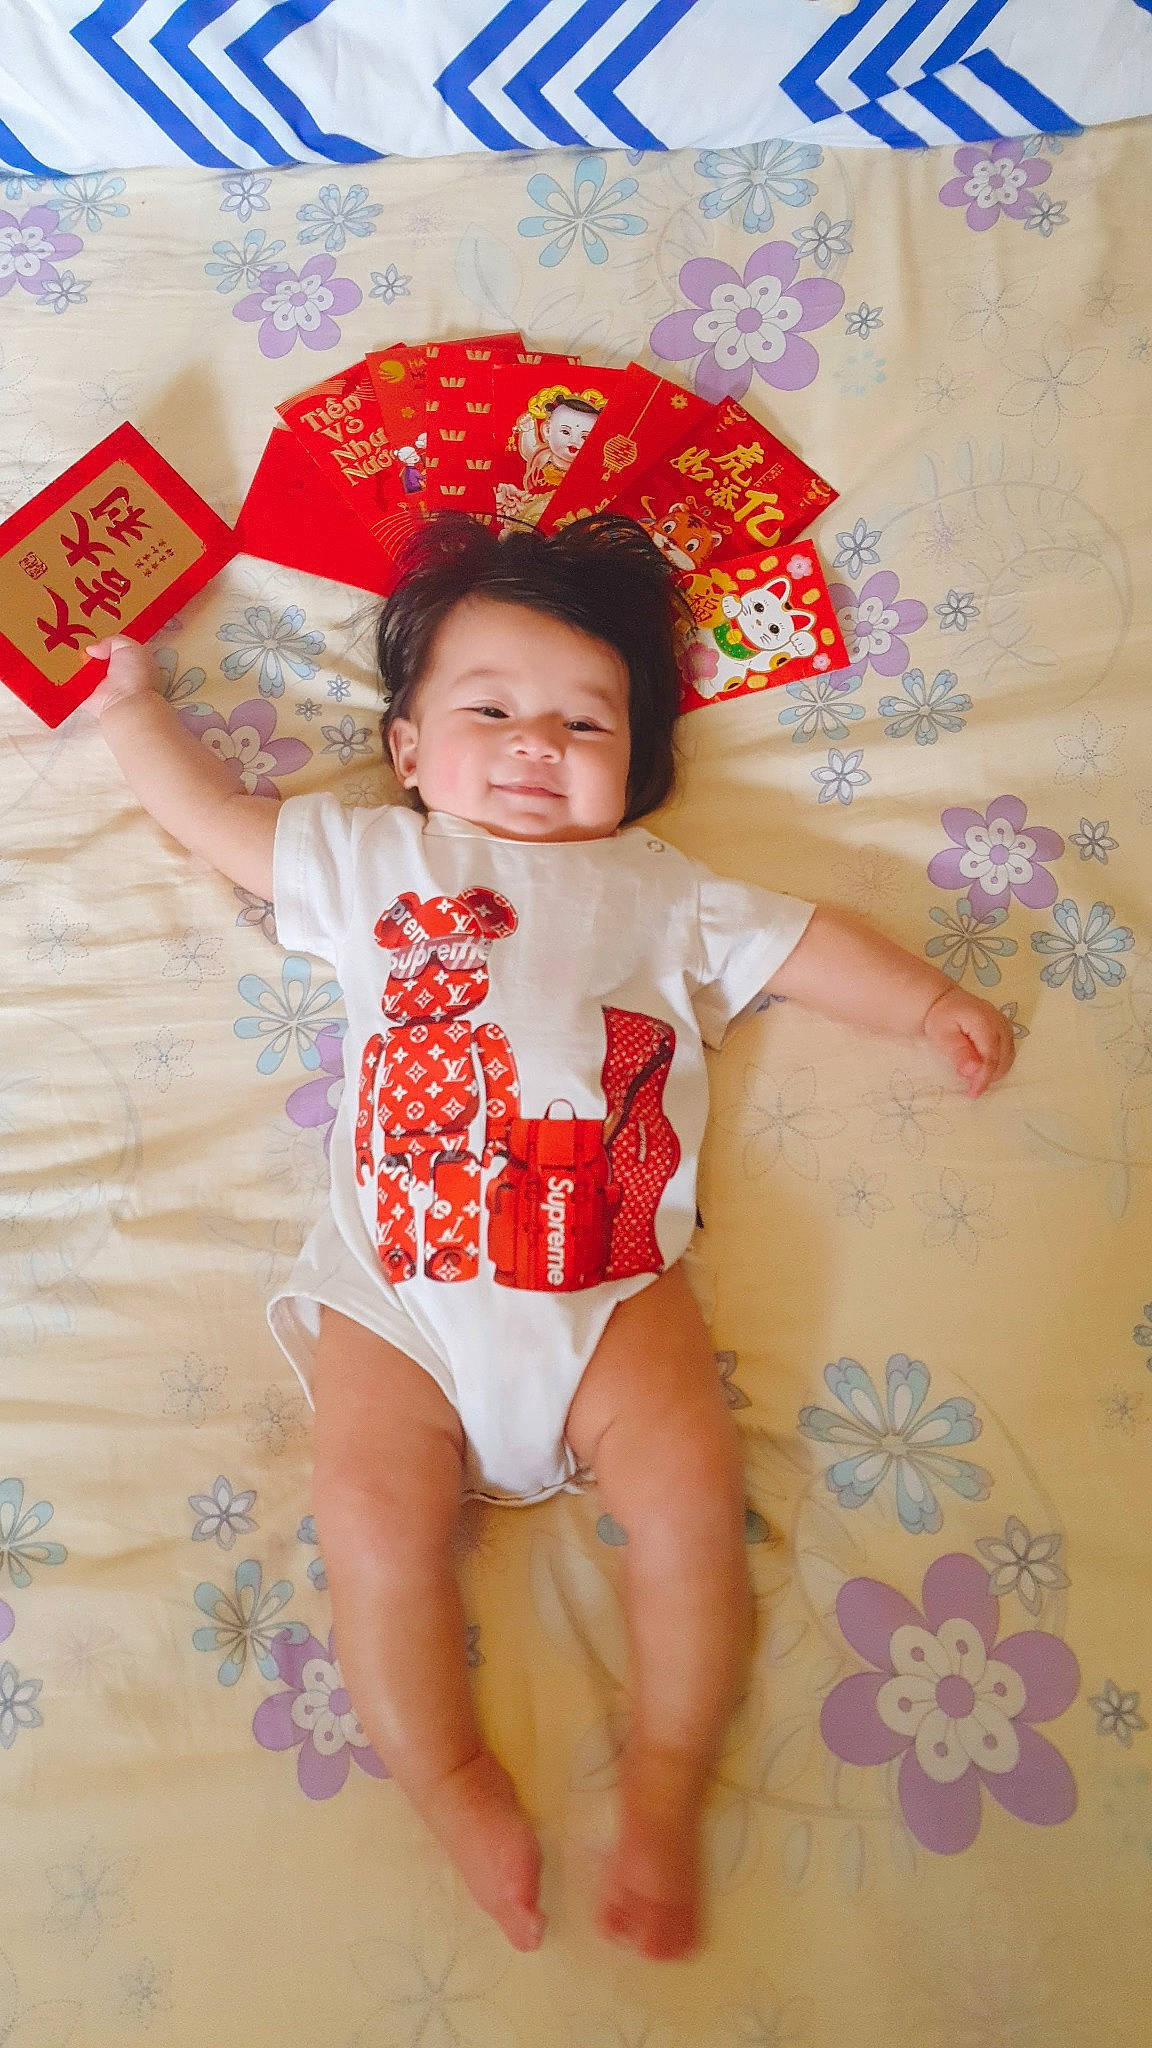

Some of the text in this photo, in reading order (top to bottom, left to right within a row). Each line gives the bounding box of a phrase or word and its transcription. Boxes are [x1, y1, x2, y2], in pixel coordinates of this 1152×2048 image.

[320, 415, 364, 443] Vô
[330, 427, 389, 468] Như
[541, 1176, 575, 1286] Supreme
